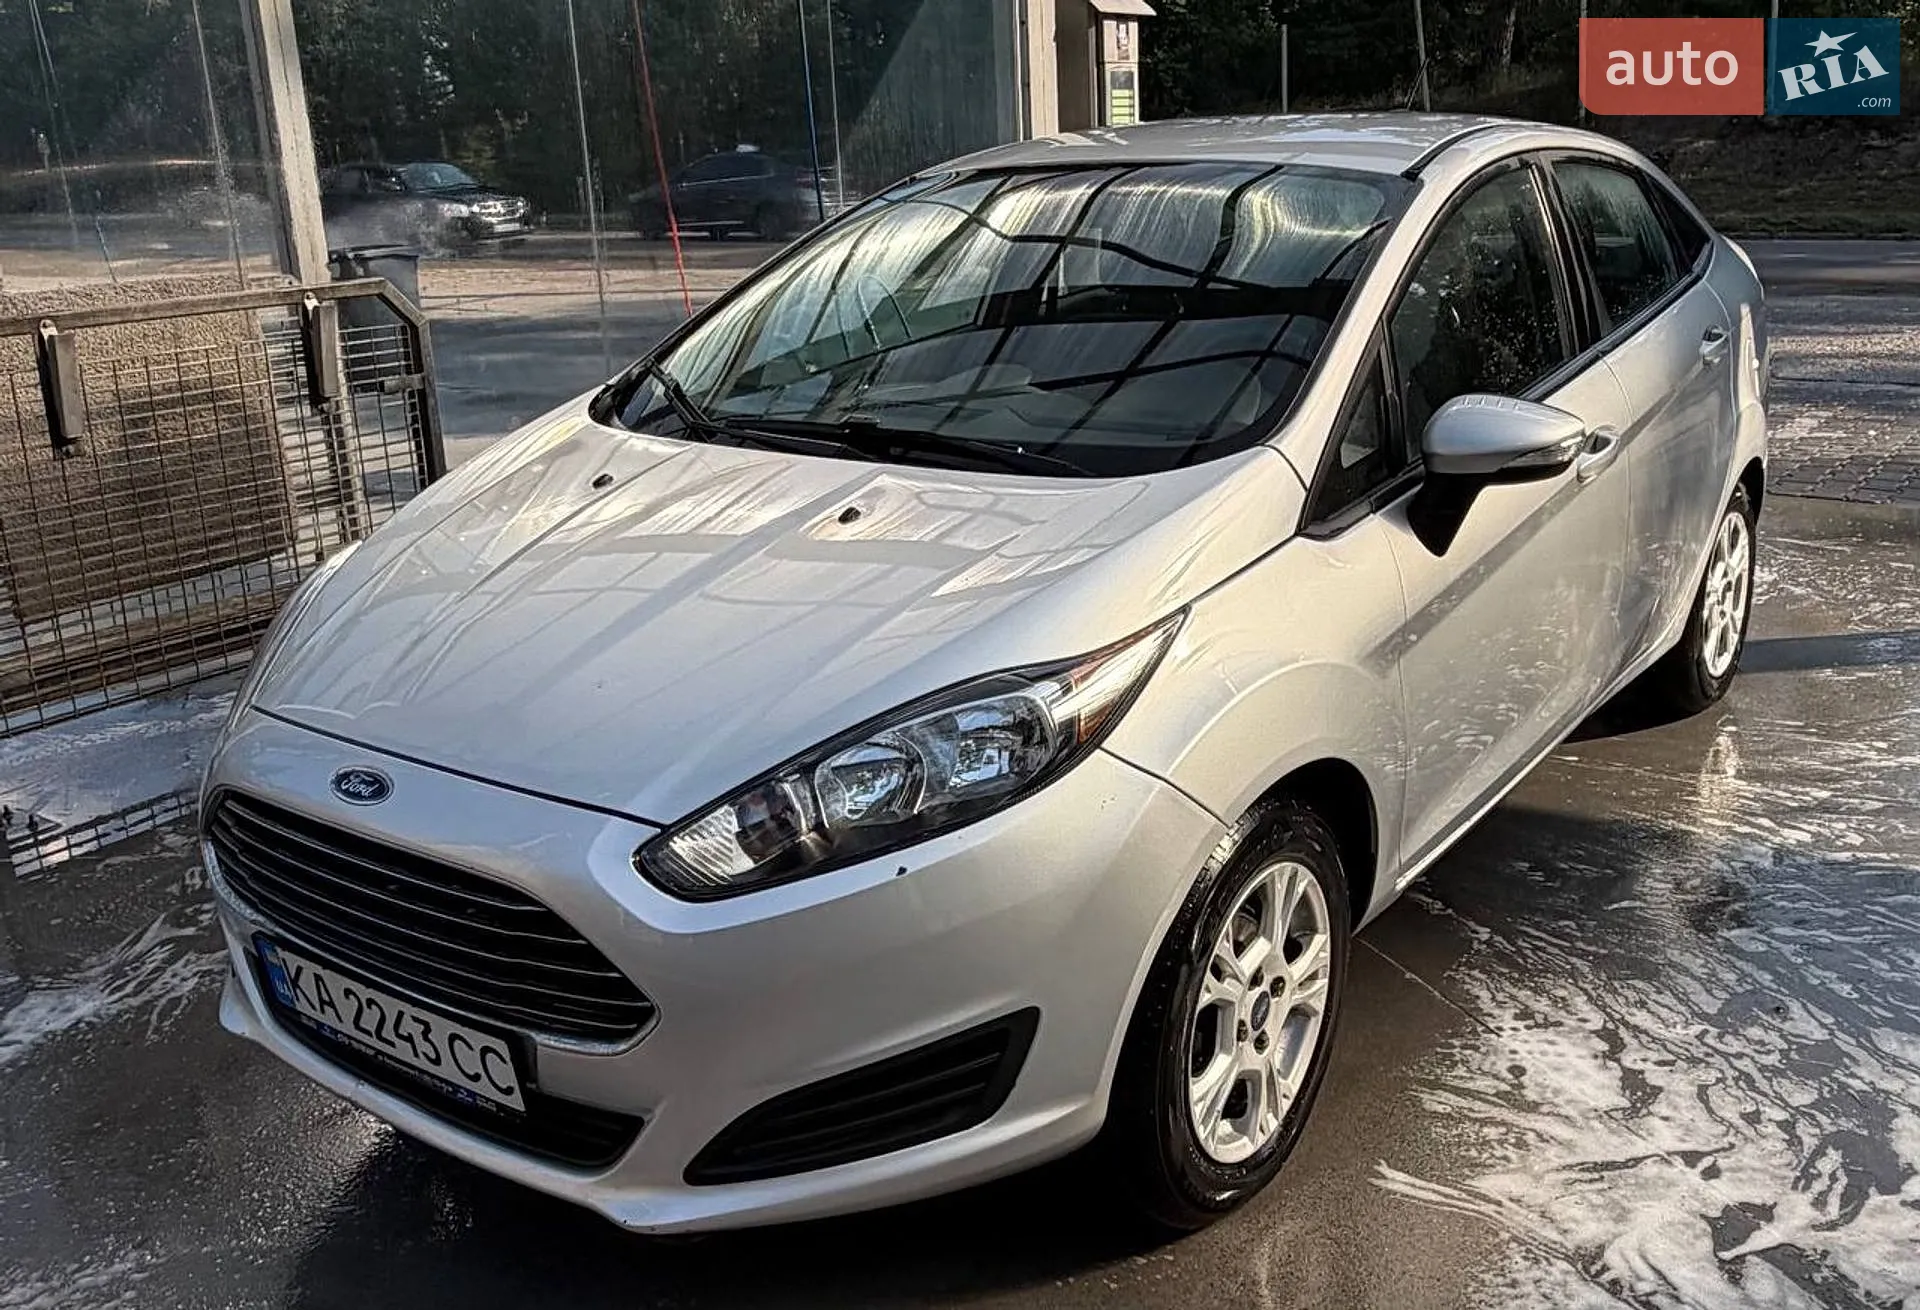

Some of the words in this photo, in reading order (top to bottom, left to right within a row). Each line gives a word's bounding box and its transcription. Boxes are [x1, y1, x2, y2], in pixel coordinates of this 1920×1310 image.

[340, 773, 381, 798] Ford
[281, 957, 344, 1024] KA
[343, 988, 443, 1067] 2243
[447, 1032, 515, 1097] CC
